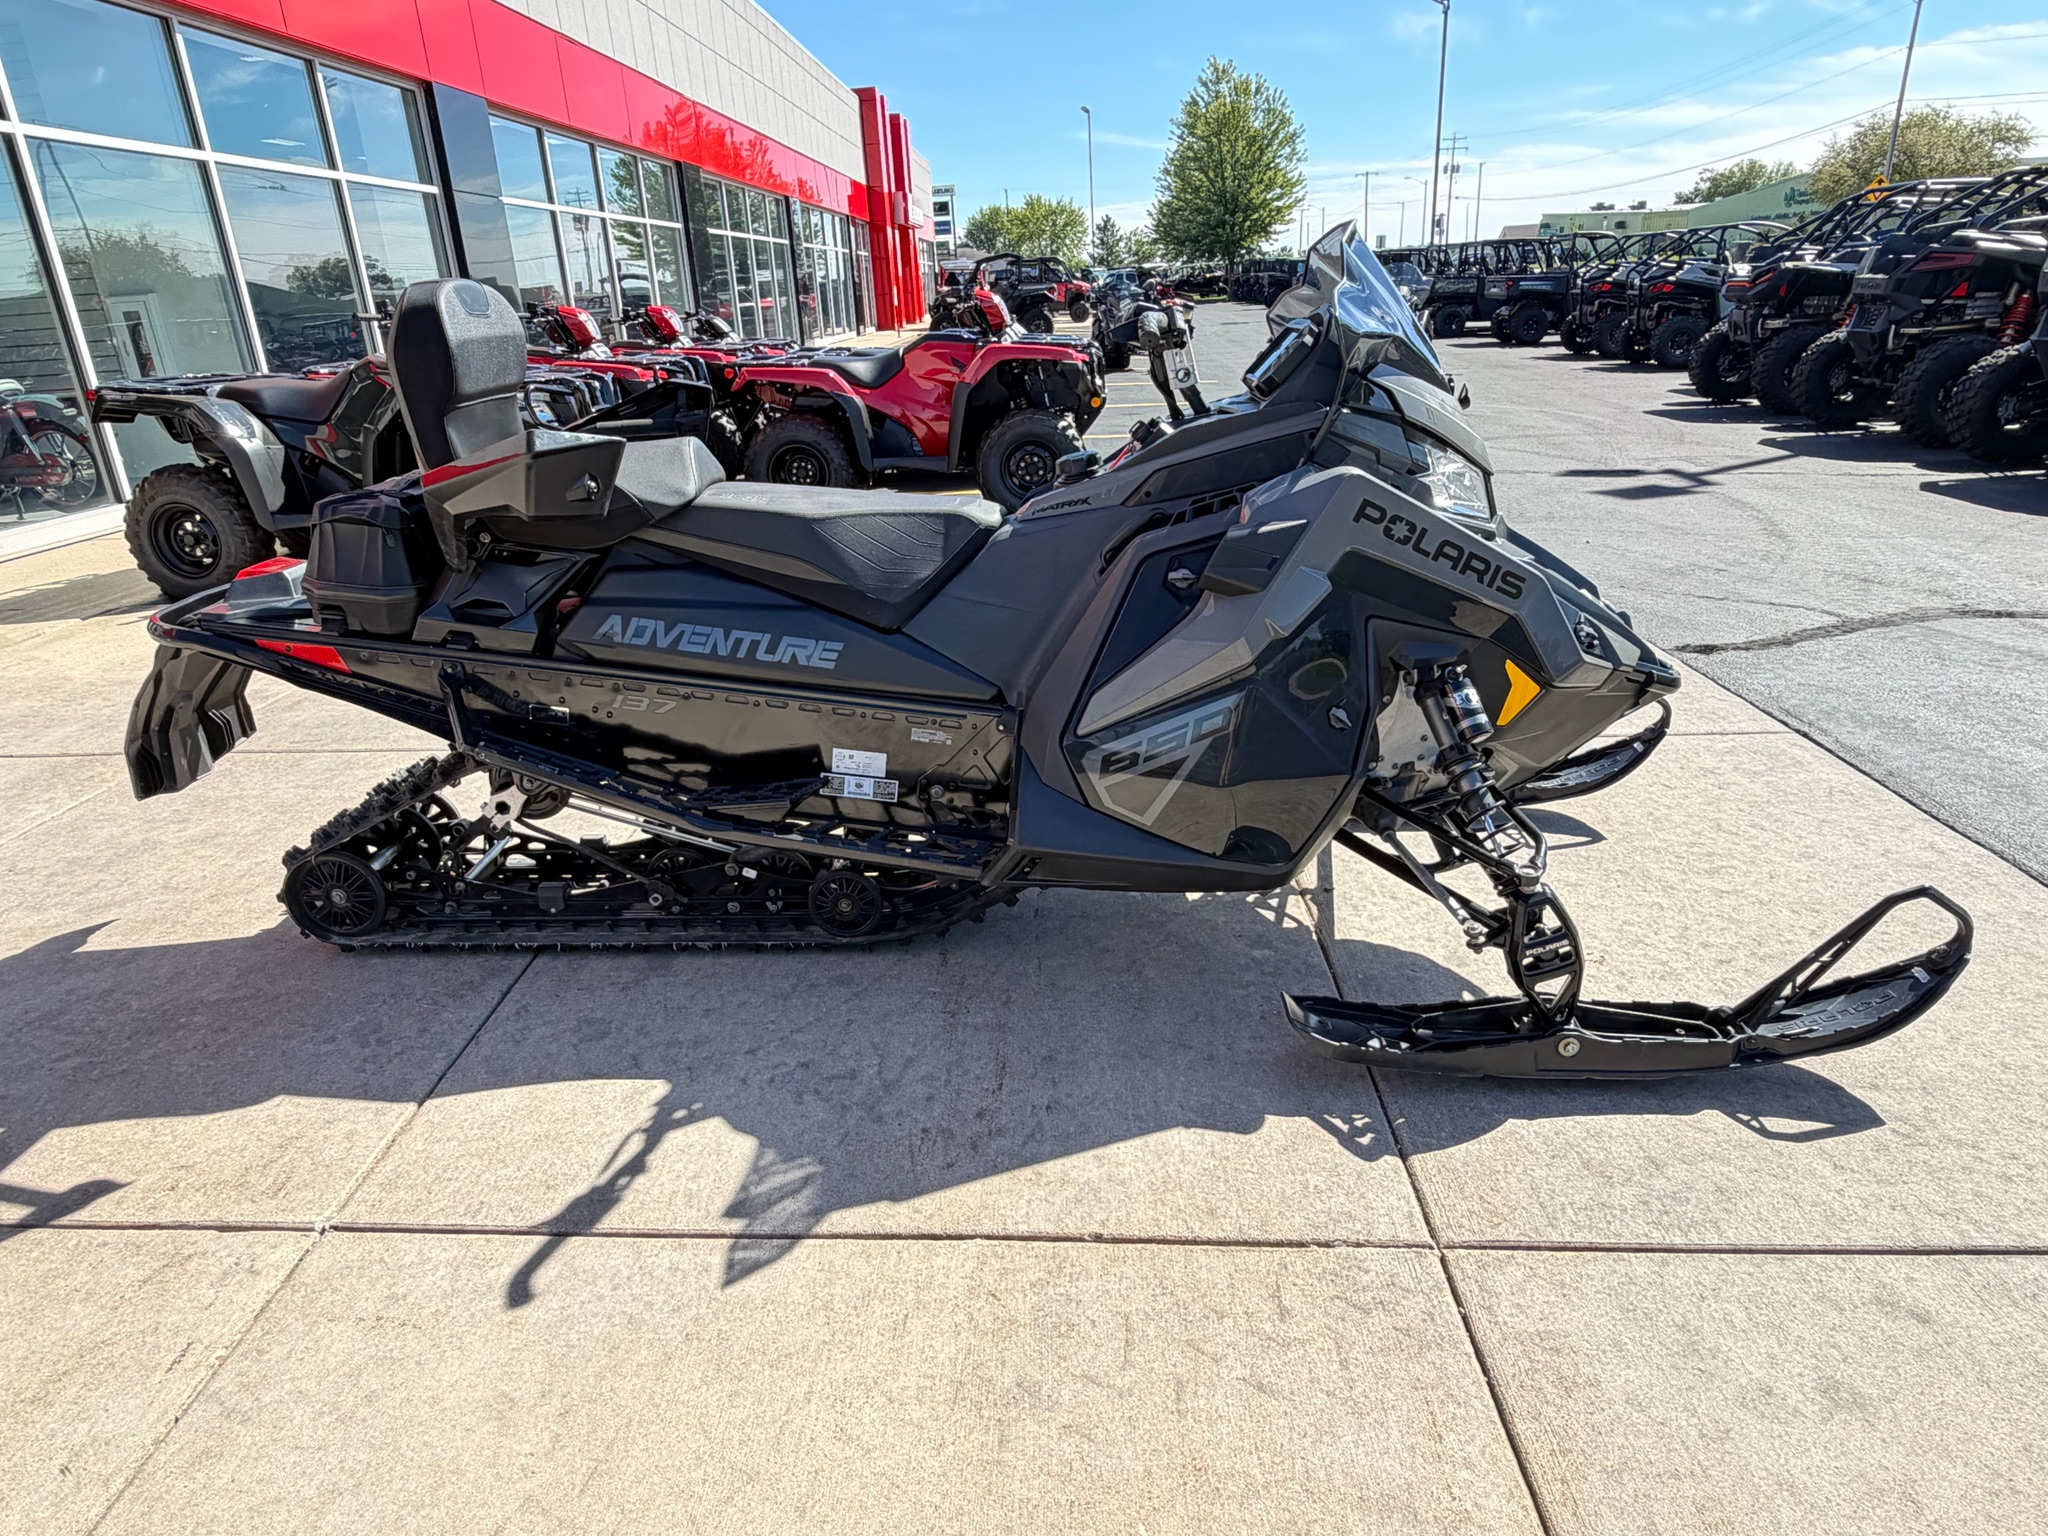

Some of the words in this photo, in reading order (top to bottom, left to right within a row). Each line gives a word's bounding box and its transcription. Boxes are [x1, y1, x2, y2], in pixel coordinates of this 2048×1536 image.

[932, 187, 954, 195] UZUKI
[1031, 496, 1092, 516] MATRYX
[1352, 498, 1527, 600] POLARIS
[592, 614, 844, 669] ADVENTURE
[612, 694, 677, 714] 137
[1099, 706, 1232, 781] 650
[1525, 939, 1570, 956] POLARIS
[1776, 990, 1896, 1032] POLARIS
